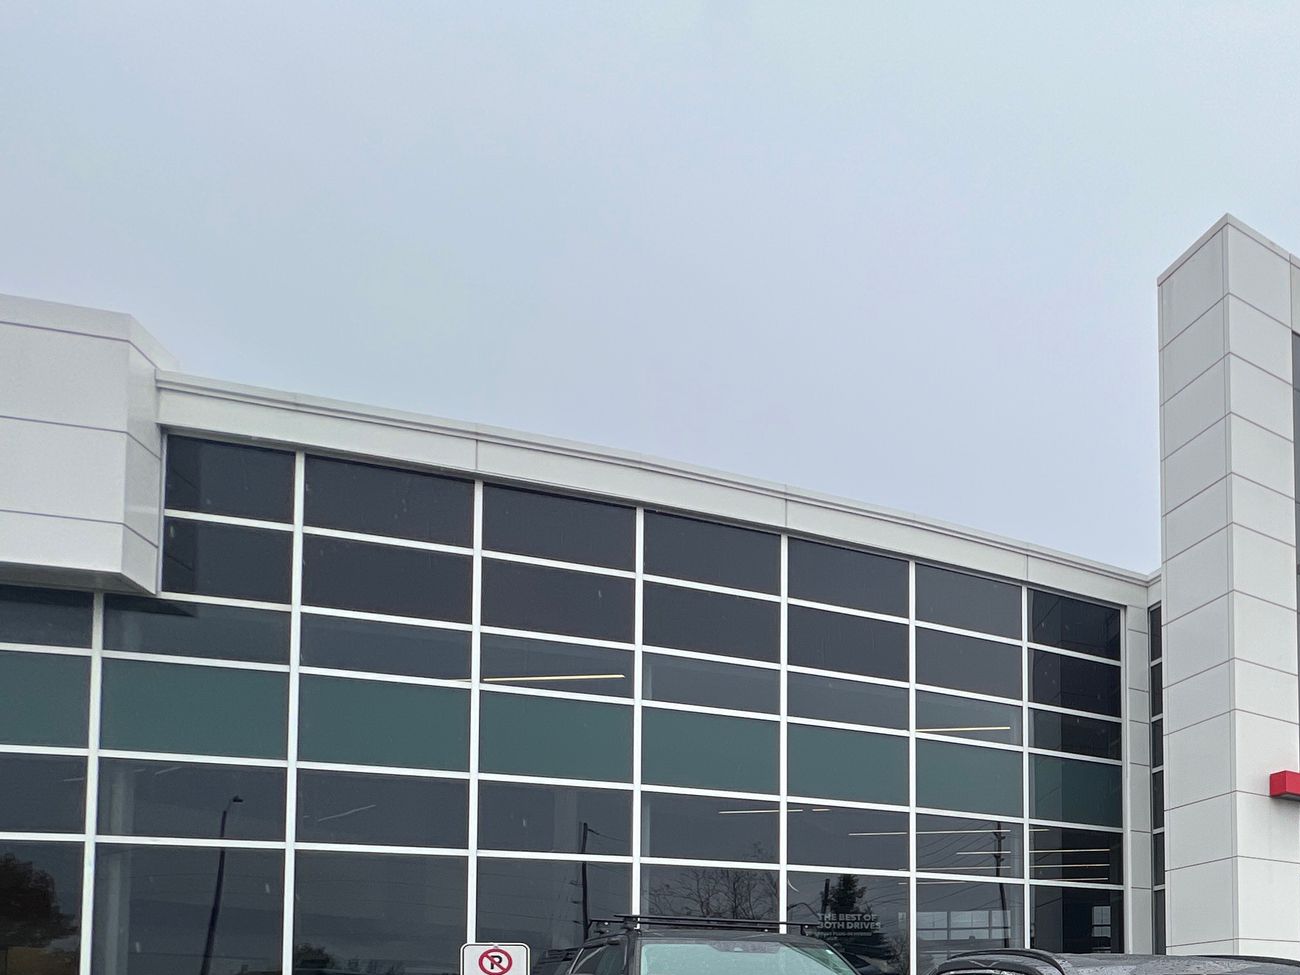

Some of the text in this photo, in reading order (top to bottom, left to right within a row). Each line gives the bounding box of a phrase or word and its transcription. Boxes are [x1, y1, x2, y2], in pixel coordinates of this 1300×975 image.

[818, 913, 877, 921] THE BEST OF
[846, 921, 881, 930] DRIVES
